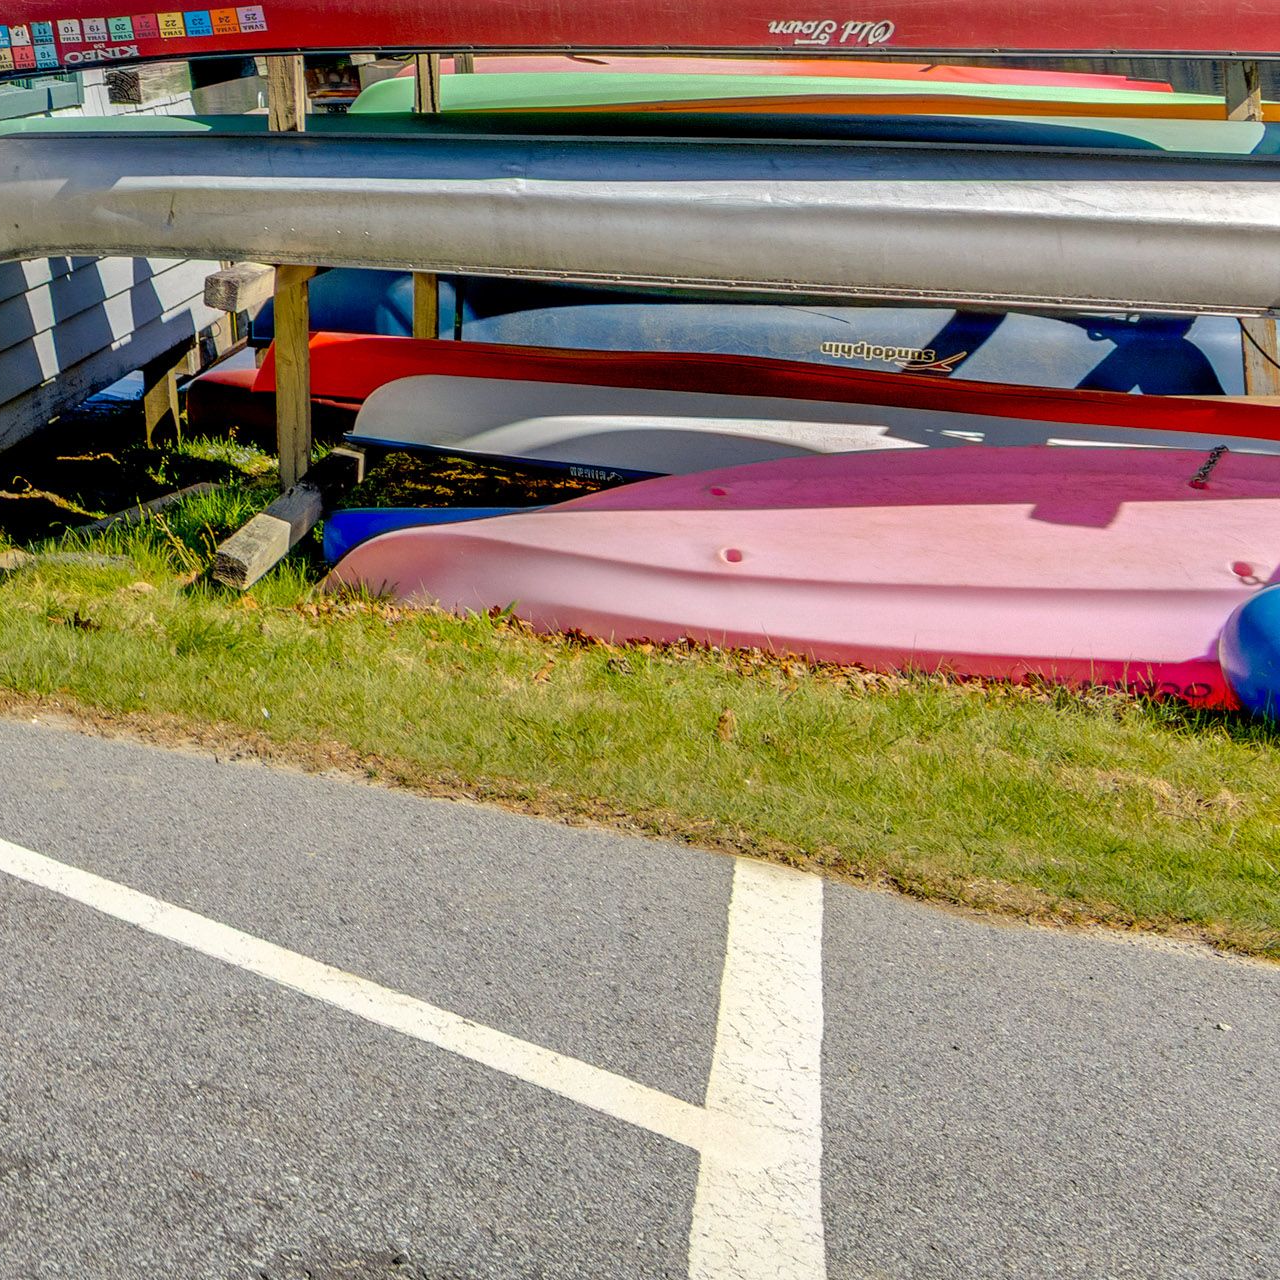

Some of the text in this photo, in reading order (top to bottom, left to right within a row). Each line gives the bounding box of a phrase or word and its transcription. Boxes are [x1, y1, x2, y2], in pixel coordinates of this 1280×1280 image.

[218, 15, 230, 23] 24
[244, 13, 258, 21] 25
[115, 23, 126, 31] 20
[165, 19, 177, 27] 22
[89, 24, 100, 32] 19
[768, 20, 895, 45] Old Town
[40, 51, 51, 59] 18
[64, 45, 139, 64] KINEO
[820, 341, 935, 362] sundolphin
